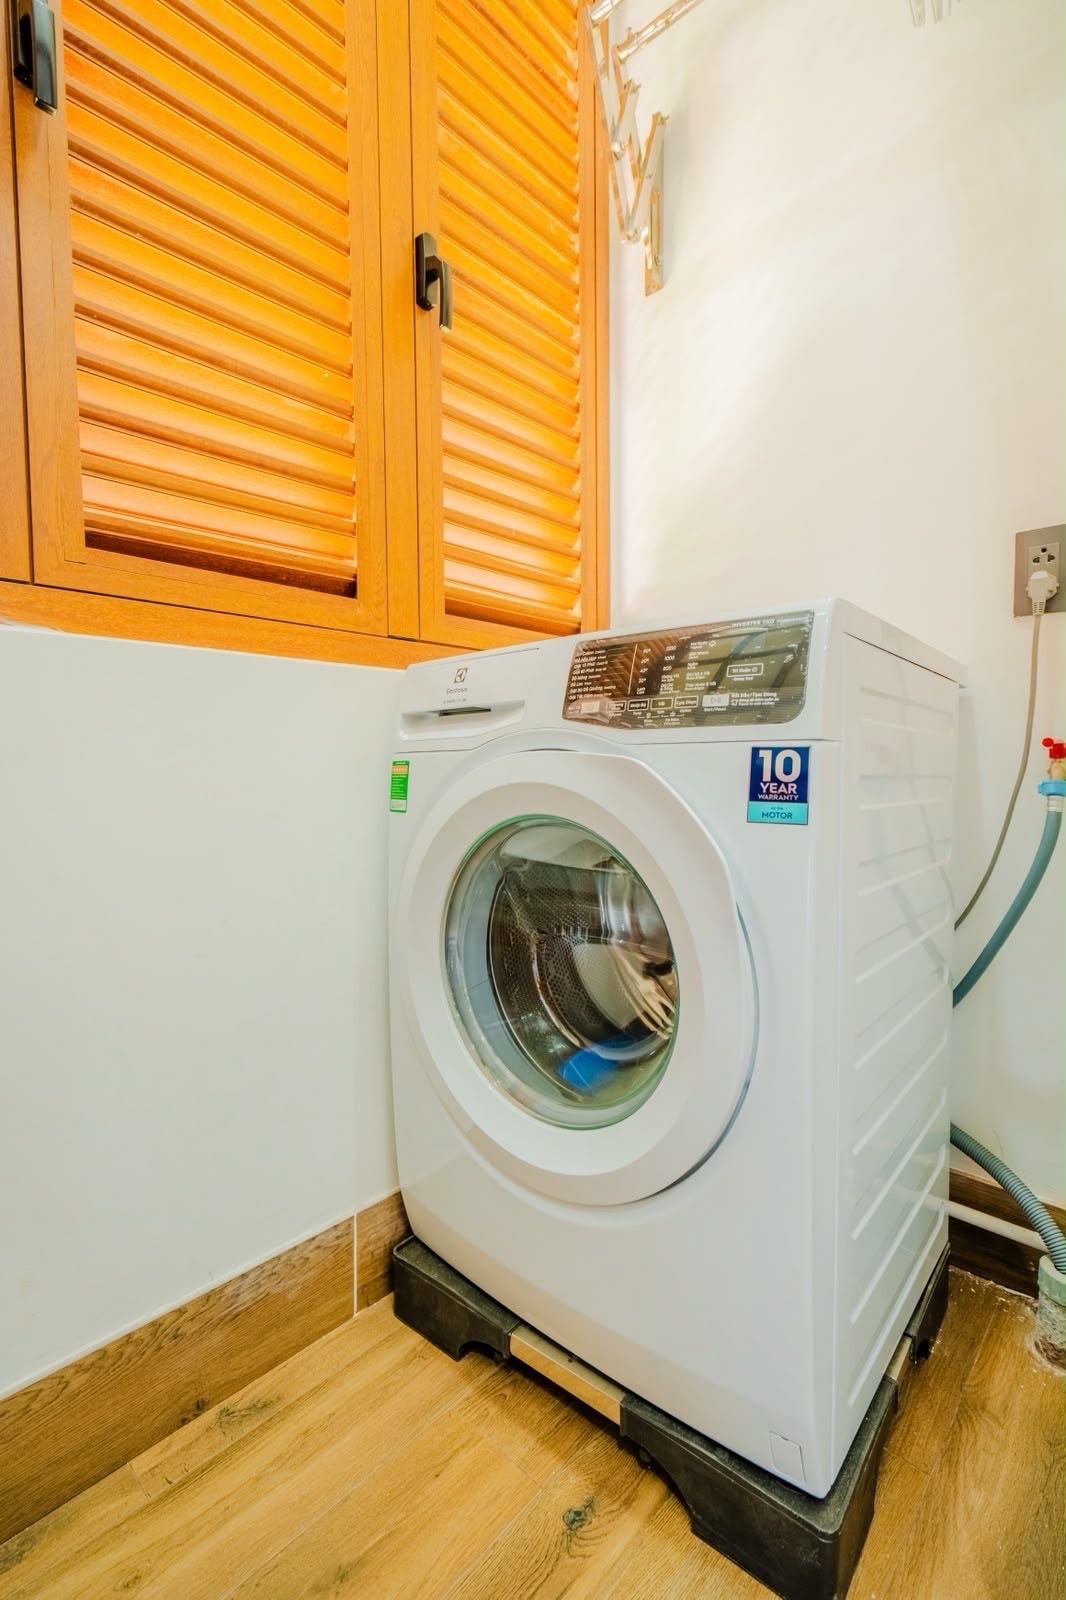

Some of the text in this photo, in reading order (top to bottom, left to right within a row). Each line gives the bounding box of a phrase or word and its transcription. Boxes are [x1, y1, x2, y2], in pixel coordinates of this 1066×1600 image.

[758, 749, 802, 783] 10
[760, 782, 798, 794] YEAR
[757, 793, 799, 801] WARRANTY
[761, 811, 793, 819] MOTOR
